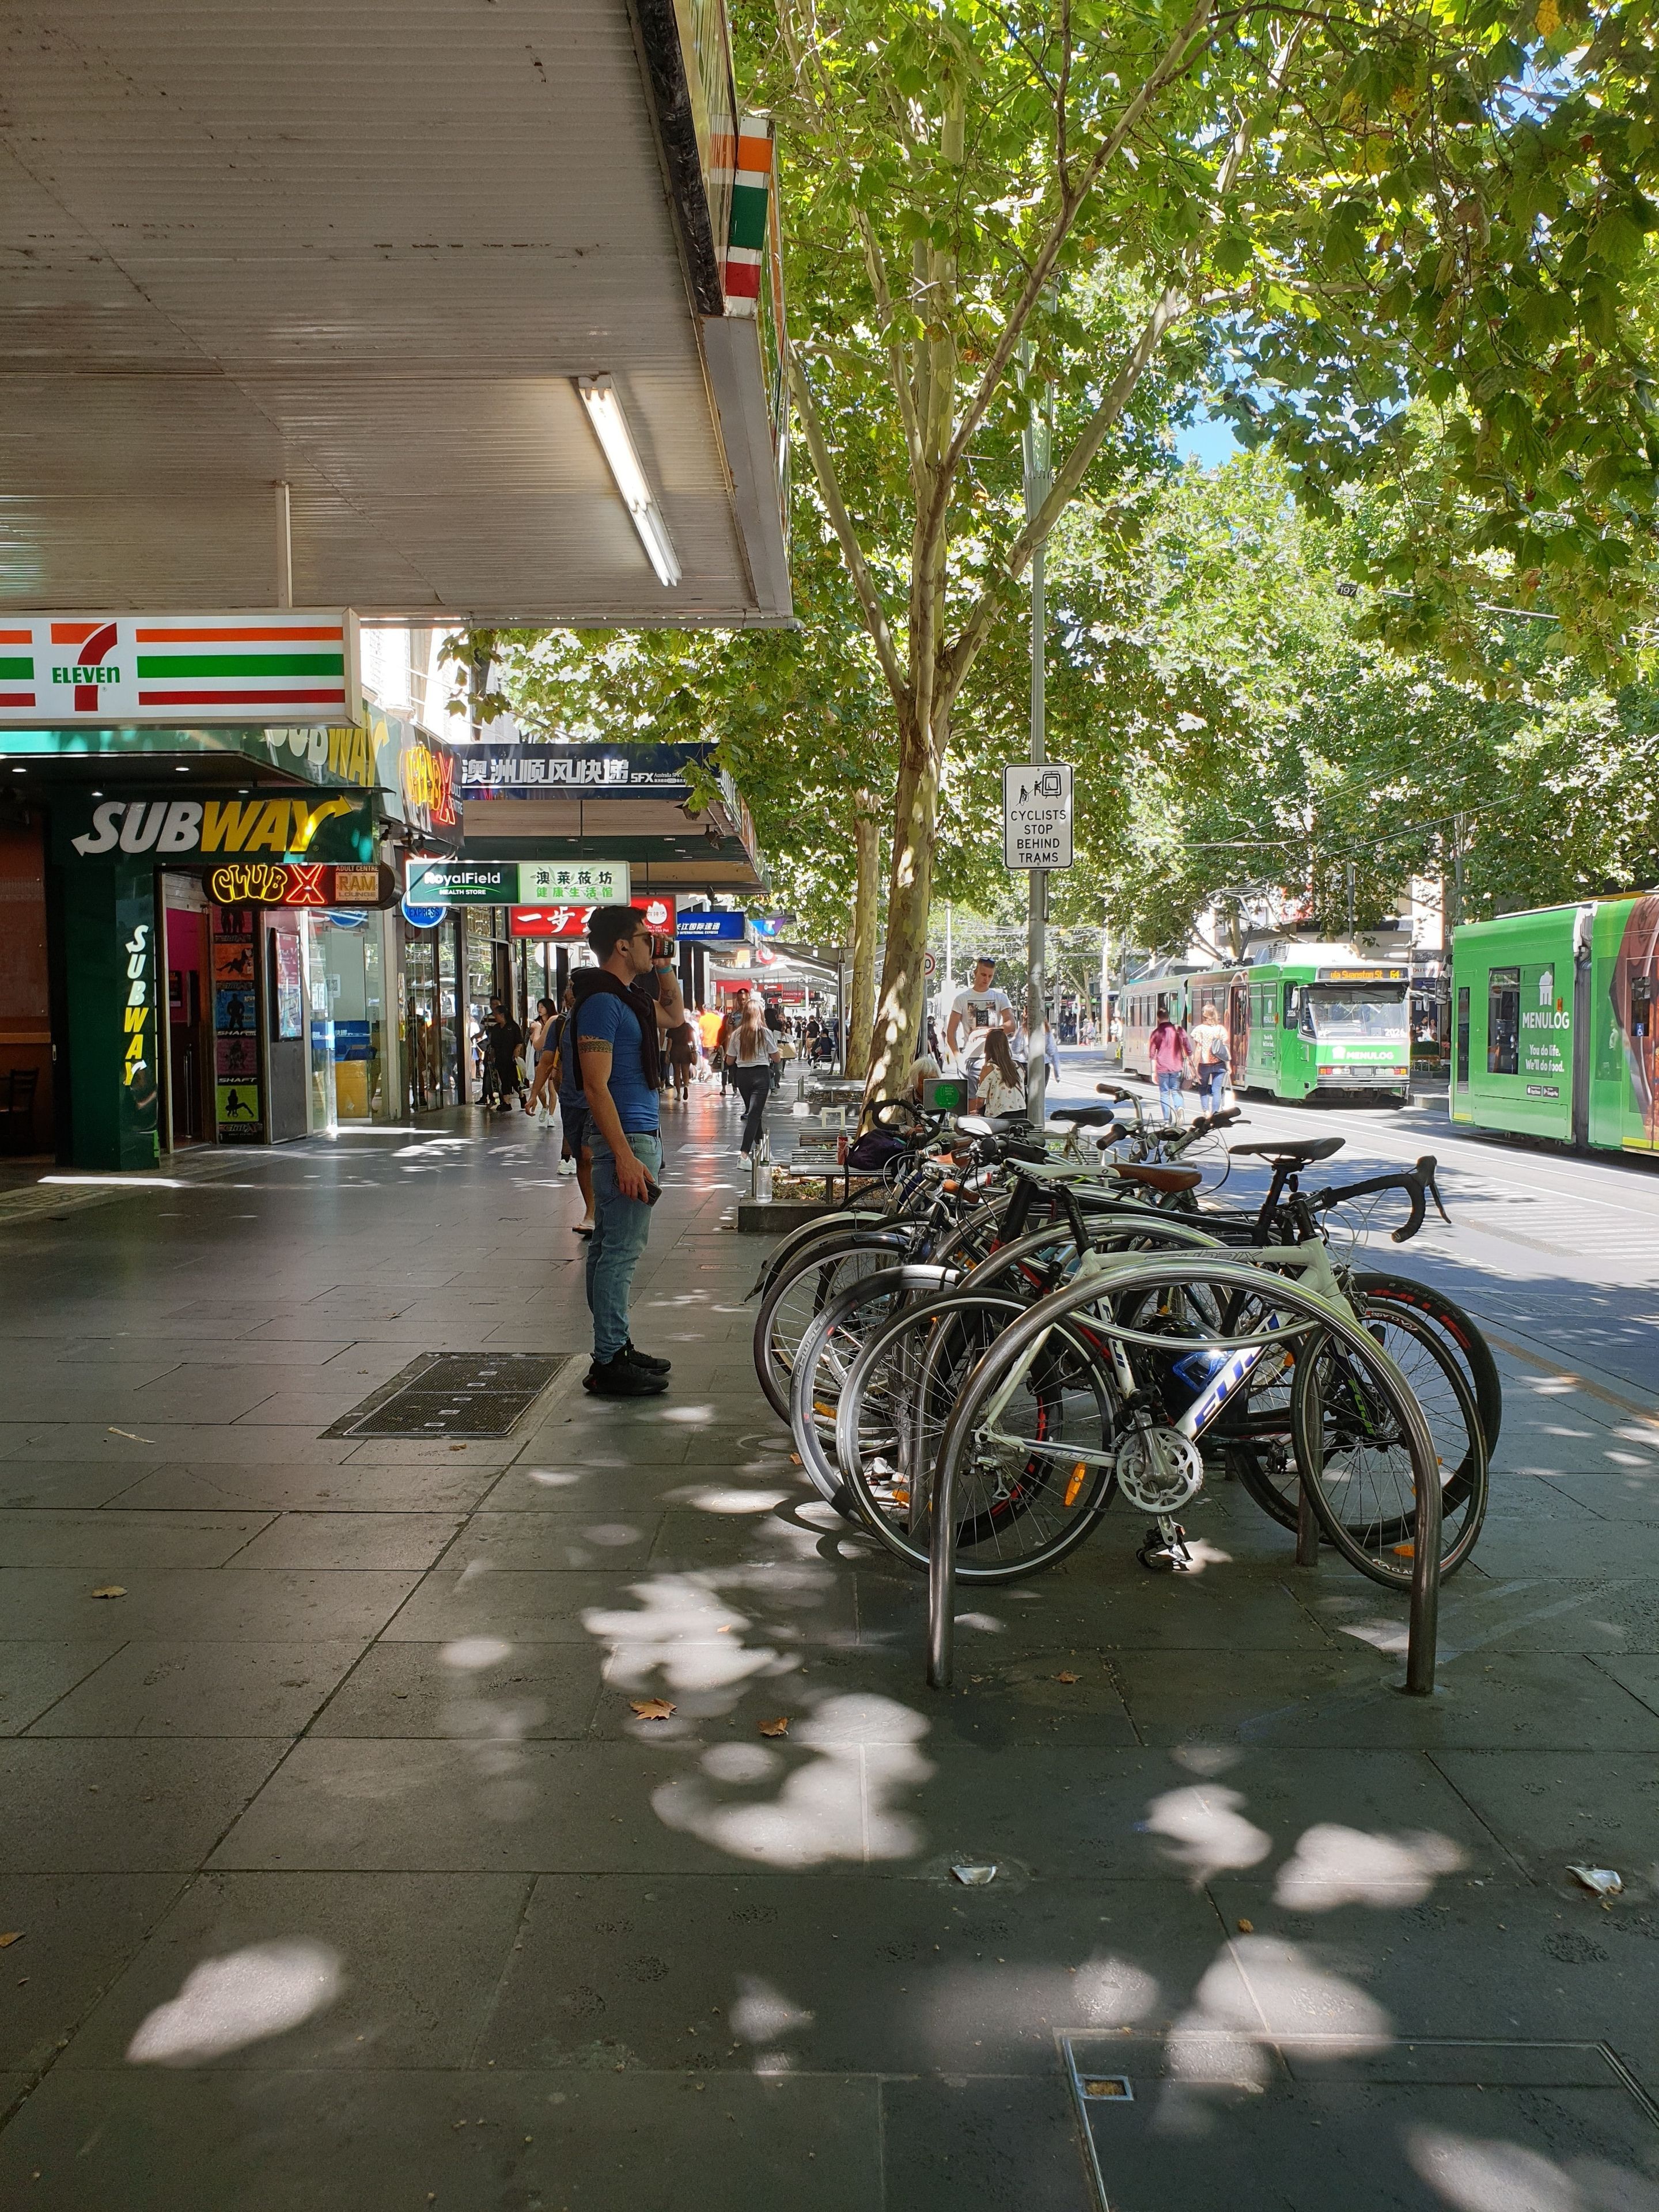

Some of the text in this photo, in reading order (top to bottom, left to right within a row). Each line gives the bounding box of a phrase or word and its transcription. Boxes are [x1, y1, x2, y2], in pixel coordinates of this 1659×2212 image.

[51, 622, 117, 711] 7
[461, 759, 630, 784] 澳洲顺风快递
[631, 773, 654, 783] SFX
[1011, 810, 1066, 821] CYCLISTS
[71, 795, 353, 857] SUBWAY
[1024, 824, 1053, 835] STOP
[1017, 838, 1060, 849] BEHIND
[1018, 853, 1059, 863] TRAMS
[212, 864, 325, 904] CLUB X
[338, 876, 376, 891] RAM
[424, 872, 501, 886] RoyalField
[409, 908, 440, 917] EXPRESS
[1342, 971, 1374, 979] Swanston
[1374, 971, 1383, 979] St
[1390, 970, 1400, 979] 64
[123, 925, 149, 1086] SUBWAY
[1522, 1012, 1569, 1029] MENULOG
[1346, 1051, 1394, 1060] MENULOG
[1529, 1044, 1560, 1056] You do life.
[1525, 1059, 1565, 1072] We'll do food.
[794, 1306, 834, 1389] SCHWALBE
[1041, 1449, 1093, 1461] FUJI
